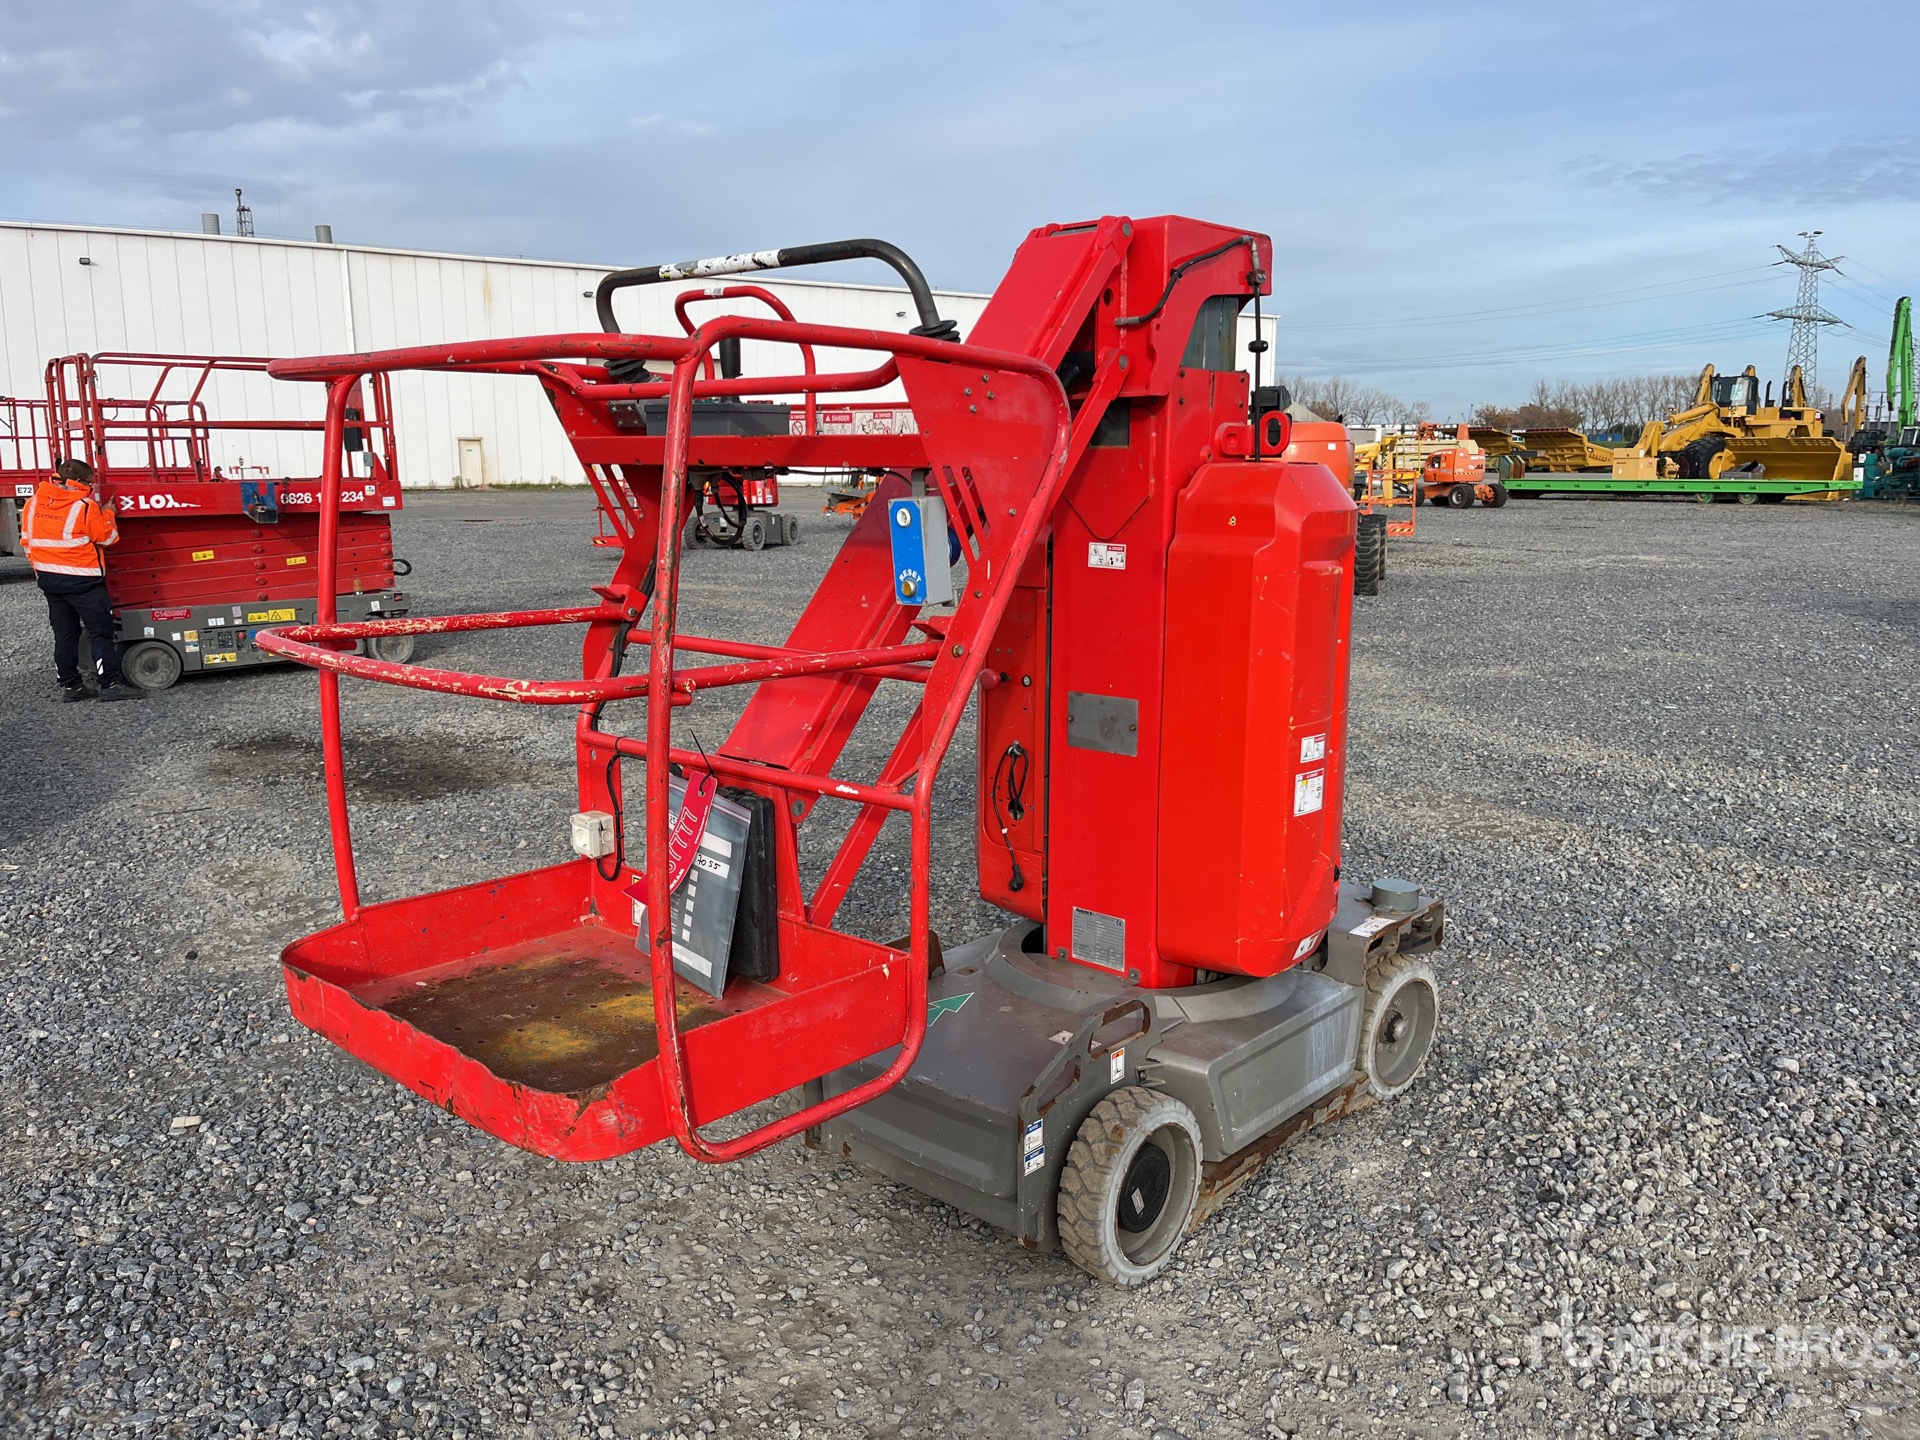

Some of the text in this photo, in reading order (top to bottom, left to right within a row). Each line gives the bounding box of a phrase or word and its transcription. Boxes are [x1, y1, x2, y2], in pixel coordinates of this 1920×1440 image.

[138, 494, 202, 510] LOX
[280, 492, 313, 504] 0826
[339, 491, 365, 503] 234
[898, 568, 922, 583] RESET
